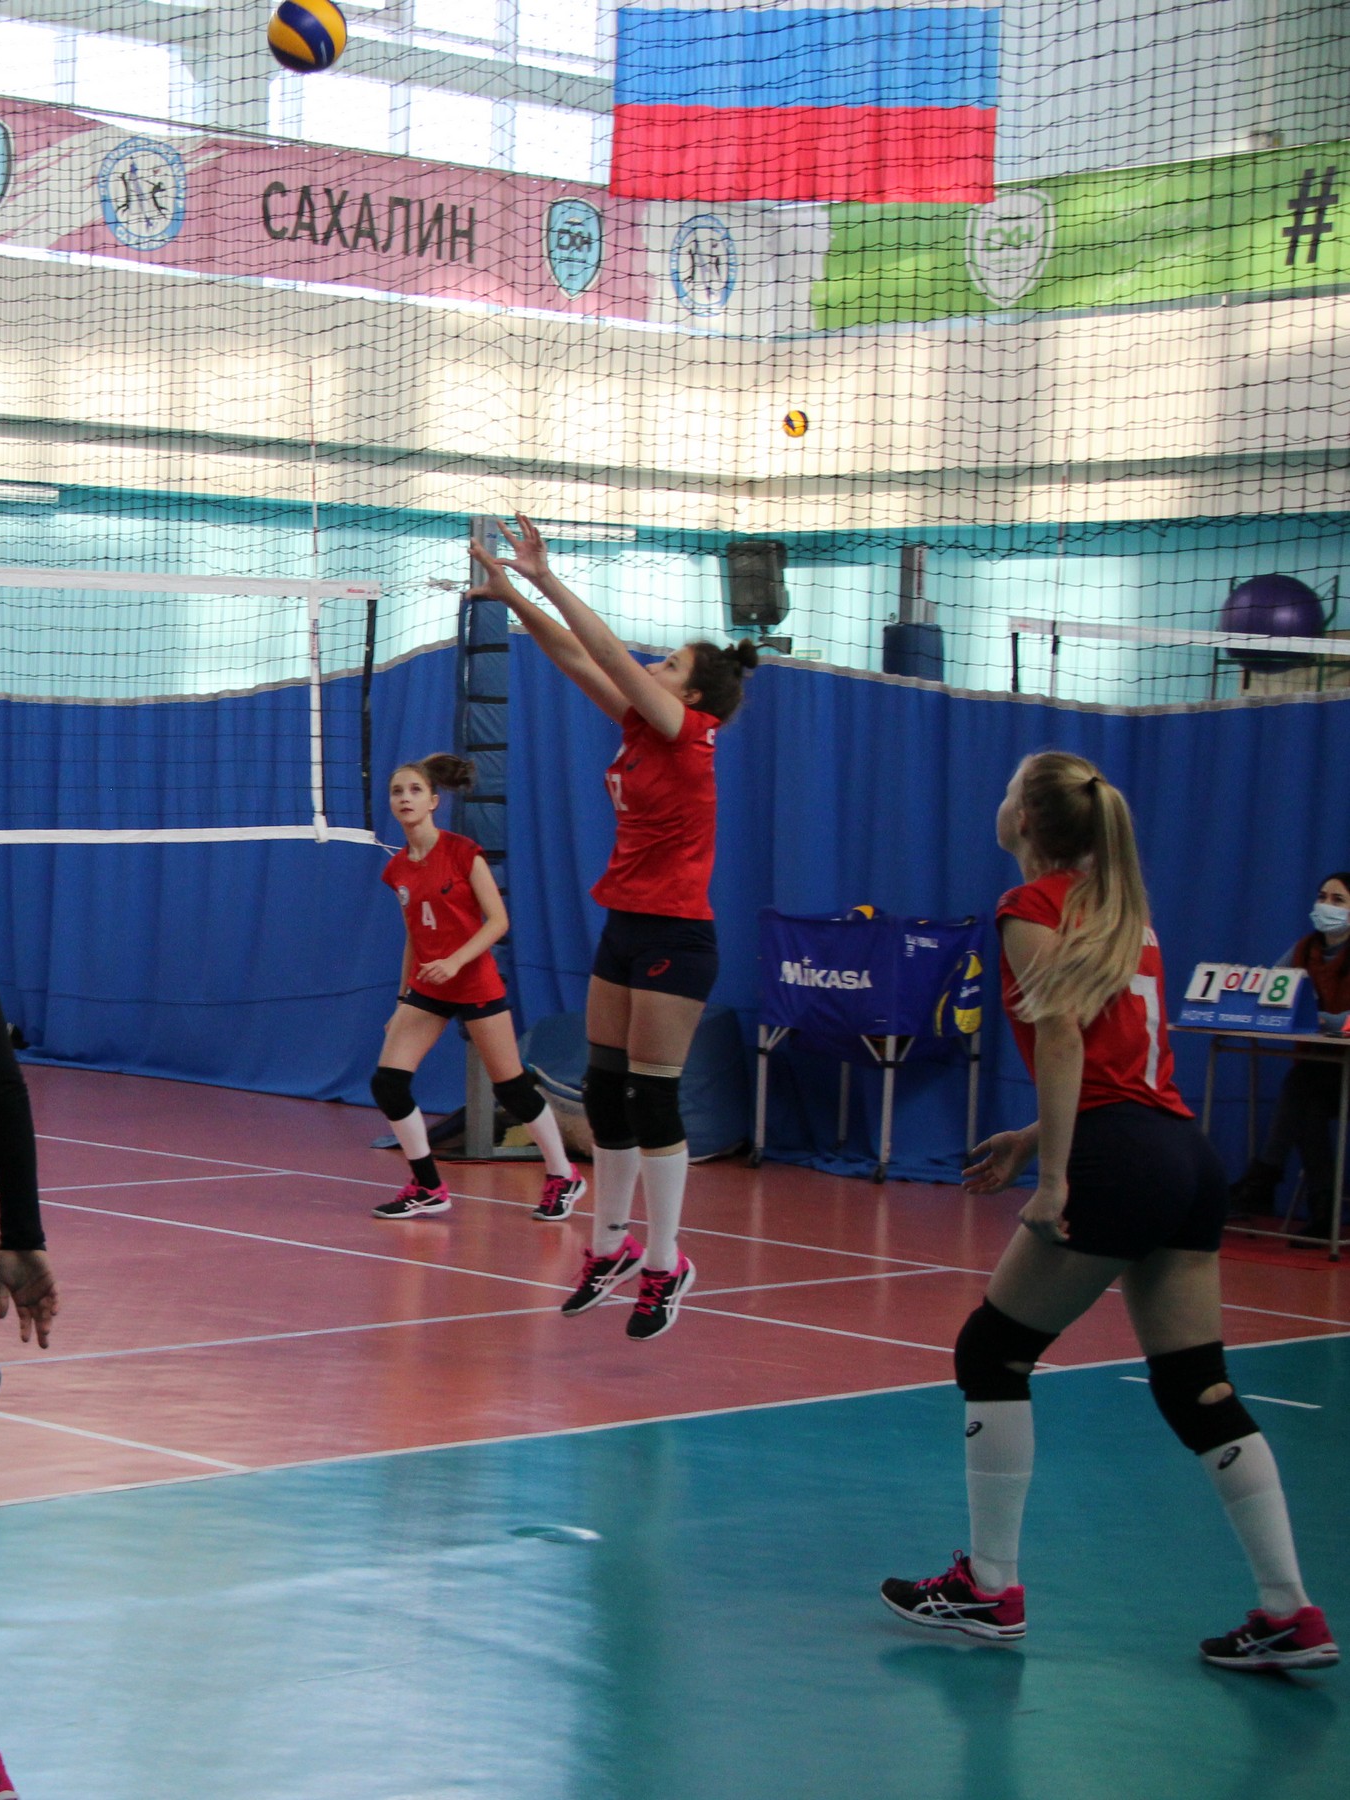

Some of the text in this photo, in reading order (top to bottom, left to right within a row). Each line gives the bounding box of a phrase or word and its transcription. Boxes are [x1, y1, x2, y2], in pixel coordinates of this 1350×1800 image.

[261, 181, 476, 264] САХАЛИН
[421, 901, 437, 930] 4
[1267, 975, 1290, 1002] 8
